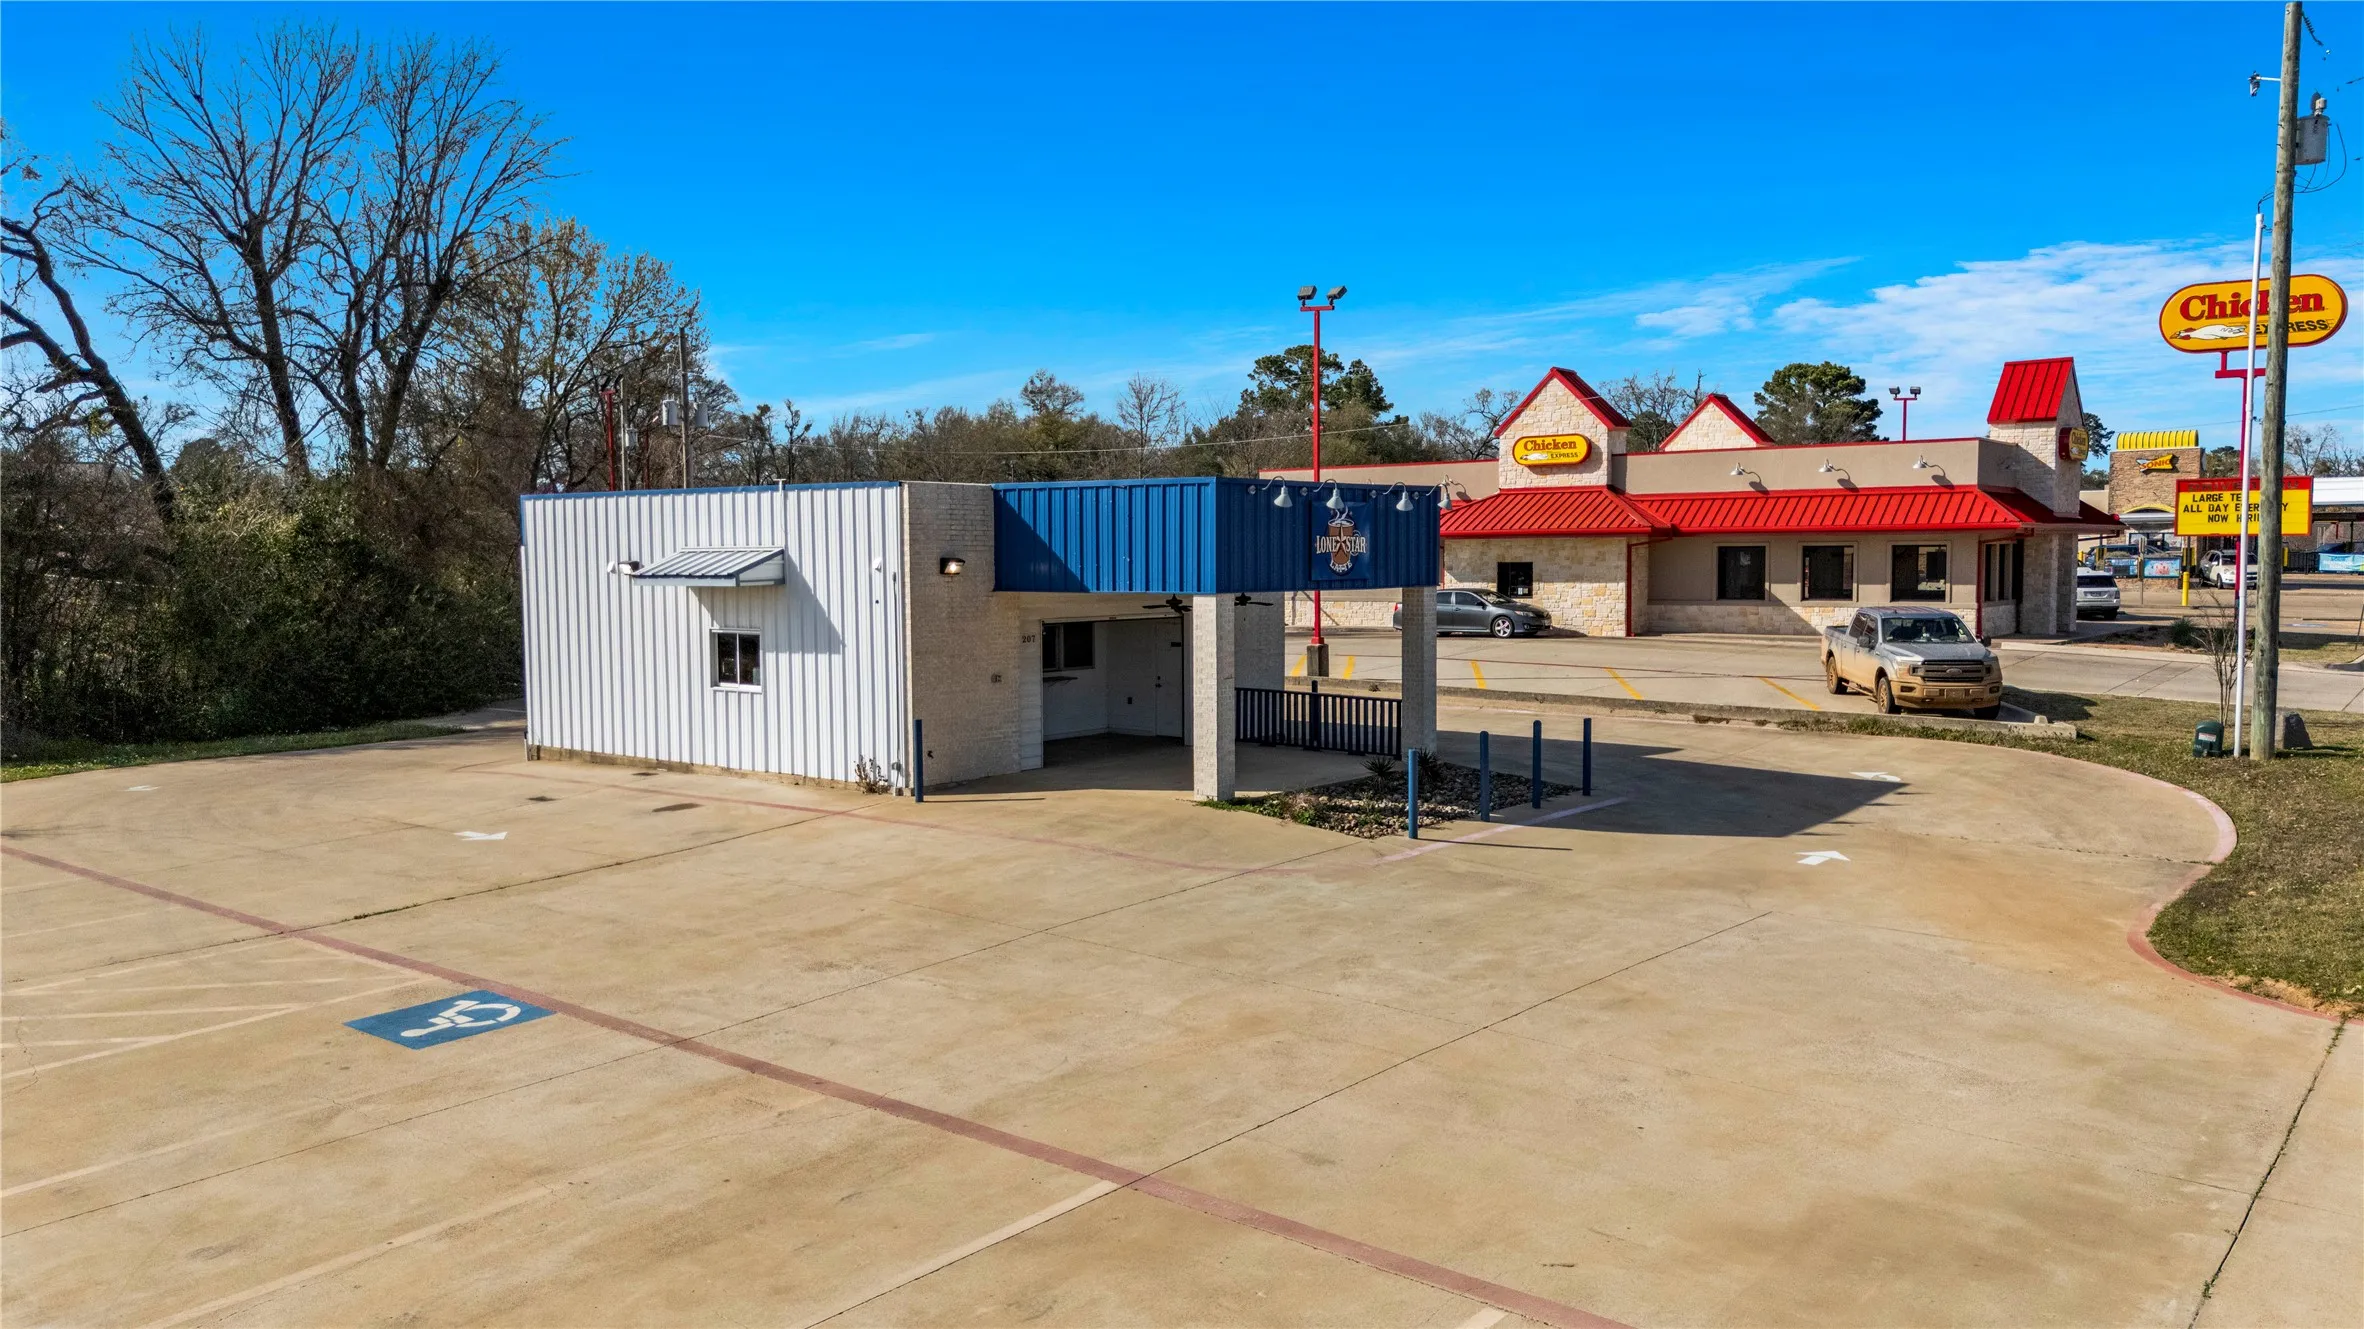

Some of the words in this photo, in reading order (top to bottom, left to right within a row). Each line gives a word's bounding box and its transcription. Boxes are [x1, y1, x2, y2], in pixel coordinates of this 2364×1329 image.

[2254, 319, 2328, 335] EXRESS
[1523, 438, 1577, 451] Chicken
[2139, 459, 2170, 469] SONIC
[2192, 493, 2223, 502] LARGE
[2183, 504, 2202, 513] ALL
[2208, 503, 2229, 512] DAY
[2235, 502, 2288, 512] EERY
[2208, 513, 2228, 522] NOW
[1316, 535, 1338, 554] LONE
[1345, 535, 1366, 553] STAR
[1021, 635, 1035, 643] 207
